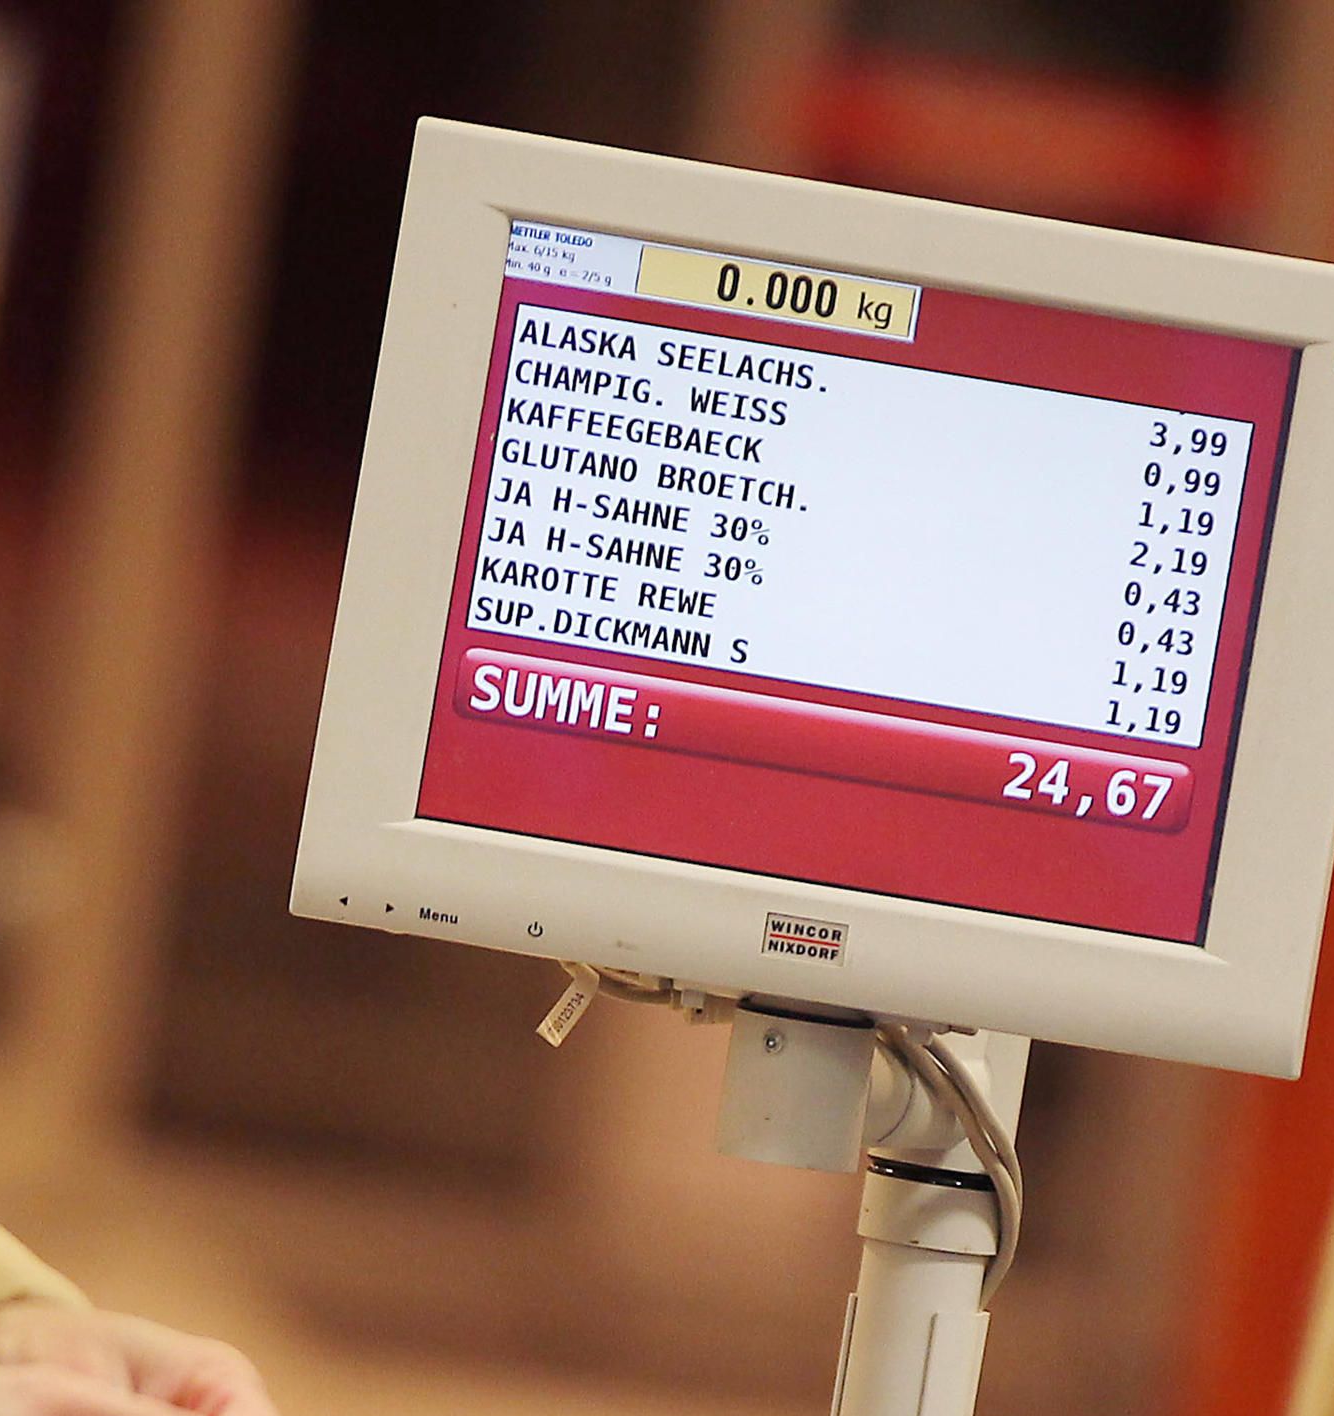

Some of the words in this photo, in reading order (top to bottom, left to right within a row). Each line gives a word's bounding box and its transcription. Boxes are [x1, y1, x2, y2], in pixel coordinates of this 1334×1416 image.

[556, 232, 593, 247] TOLEDO
[562, 250, 576, 262] kg
[717, 263, 837, 317] 0.000
[857, 291, 892, 329] kg
[515, 359, 663, 407] CHAMPIG.
[690, 386, 788, 426] WEISS
[1144, 462, 1221, 497] 0,99
[519, 319, 636, 361] ALASKA
[657, 341, 827, 393] SEELACHS.
[1149, 421, 1228, 457] 3,99
[501, 438, 638, 483] GLUTANO
[657, 464, 808, 512] BROETCH.
[1130, 541, 1208, 577] 2,19
[507, 398, 763, 464] KAFFEEGEBAECK
[1138, 501, 1214, 537] 1,19
[488, 517, 525, 547] JA
[546, 526, 683, 573] H-SAHNE
[704, 552, 764, 586] 30%
[1118, 621, 1194, 656] 0,43
[494, 477, 532, 507] JA
[553, 486, 691, 533] H-SAHNE
[710, 512, 770, 546] 30%
[1124, 581, 1201, 616] 0,43
[475, 596, 711, 658] SUP.DICKMANN
[730, 638, 749, 664] S
[1105, 700, 1182, 735] 1,19
[481, 556, 619, 603] KAROTTE
[638, 582, 717, 619] REWE
[1112, 660, 1188, 696] 1,19
[469, 665, 661, 739] SUMME:
[1003, 753, 1173, 821] 24,67
[419, 907, 459, 924] Menu
[768, 939, 839, 960] NIXDORF
[771, 920, 842, 941] WINCOR
